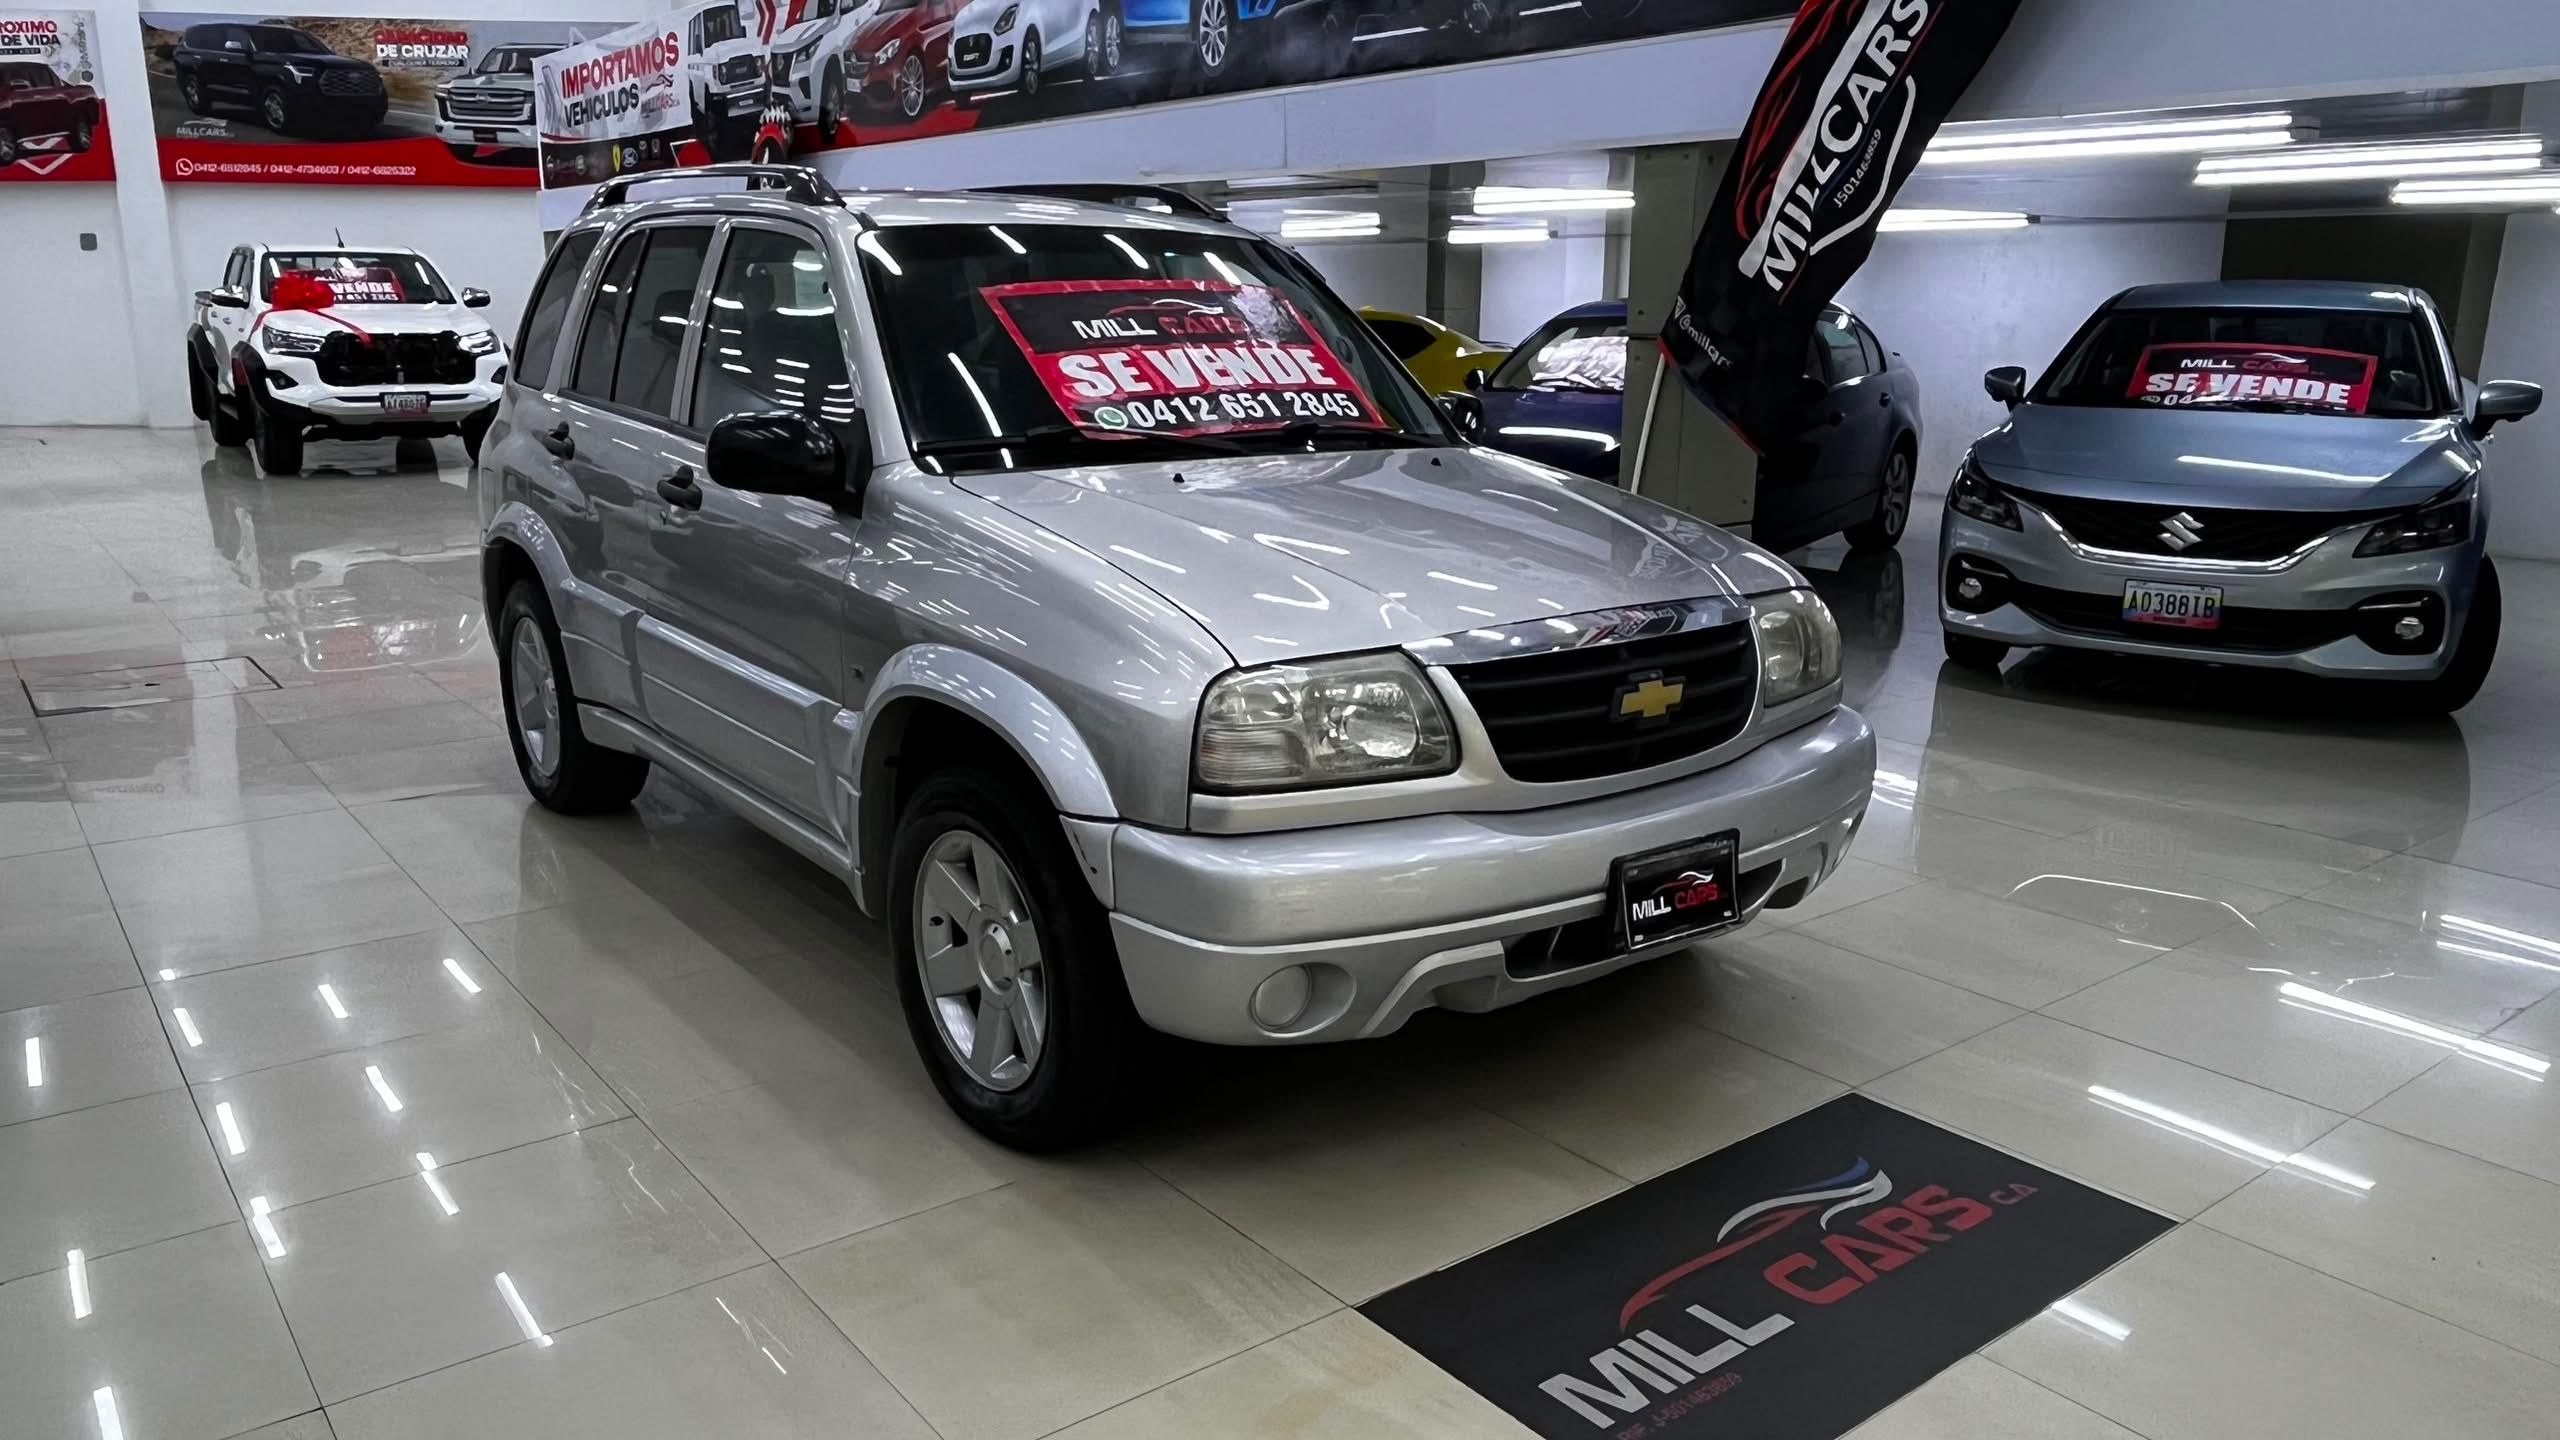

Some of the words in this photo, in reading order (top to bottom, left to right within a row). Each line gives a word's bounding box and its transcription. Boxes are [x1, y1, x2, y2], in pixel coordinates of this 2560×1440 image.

[1, 34, 22, 47] DE
[24, 34, 61, 47] VIDA
[376, 44, 398, 58] DE
[401, 44, 468, 59] CRUZAR
[561, 31, 680, 99] IMPORTAMOS
[564, 83, 640, 128] VEHICULOS
[328, 281, 395, 294] VENDE
[1071, 318, 1158, 339] MILL
[1058, 351, 1154, 399] SE
[1143, 345, 1338, 390] VENDE
[2181, 359, 2236, 369] MILL
[2208, 374, 2352, 404] VENDE
[1126, 397, 1219, 428] 0412
[1222, 393, 1280, 419] 651
[1289, 391, 1361, 418] 2845
[1632, 896, 1672, 921] MILL
[1674, 883, 1719, 909] CARS
[1538, 1303, 1795, 1430] MILL
[1763, 1184, 1993, 1304] CARS
